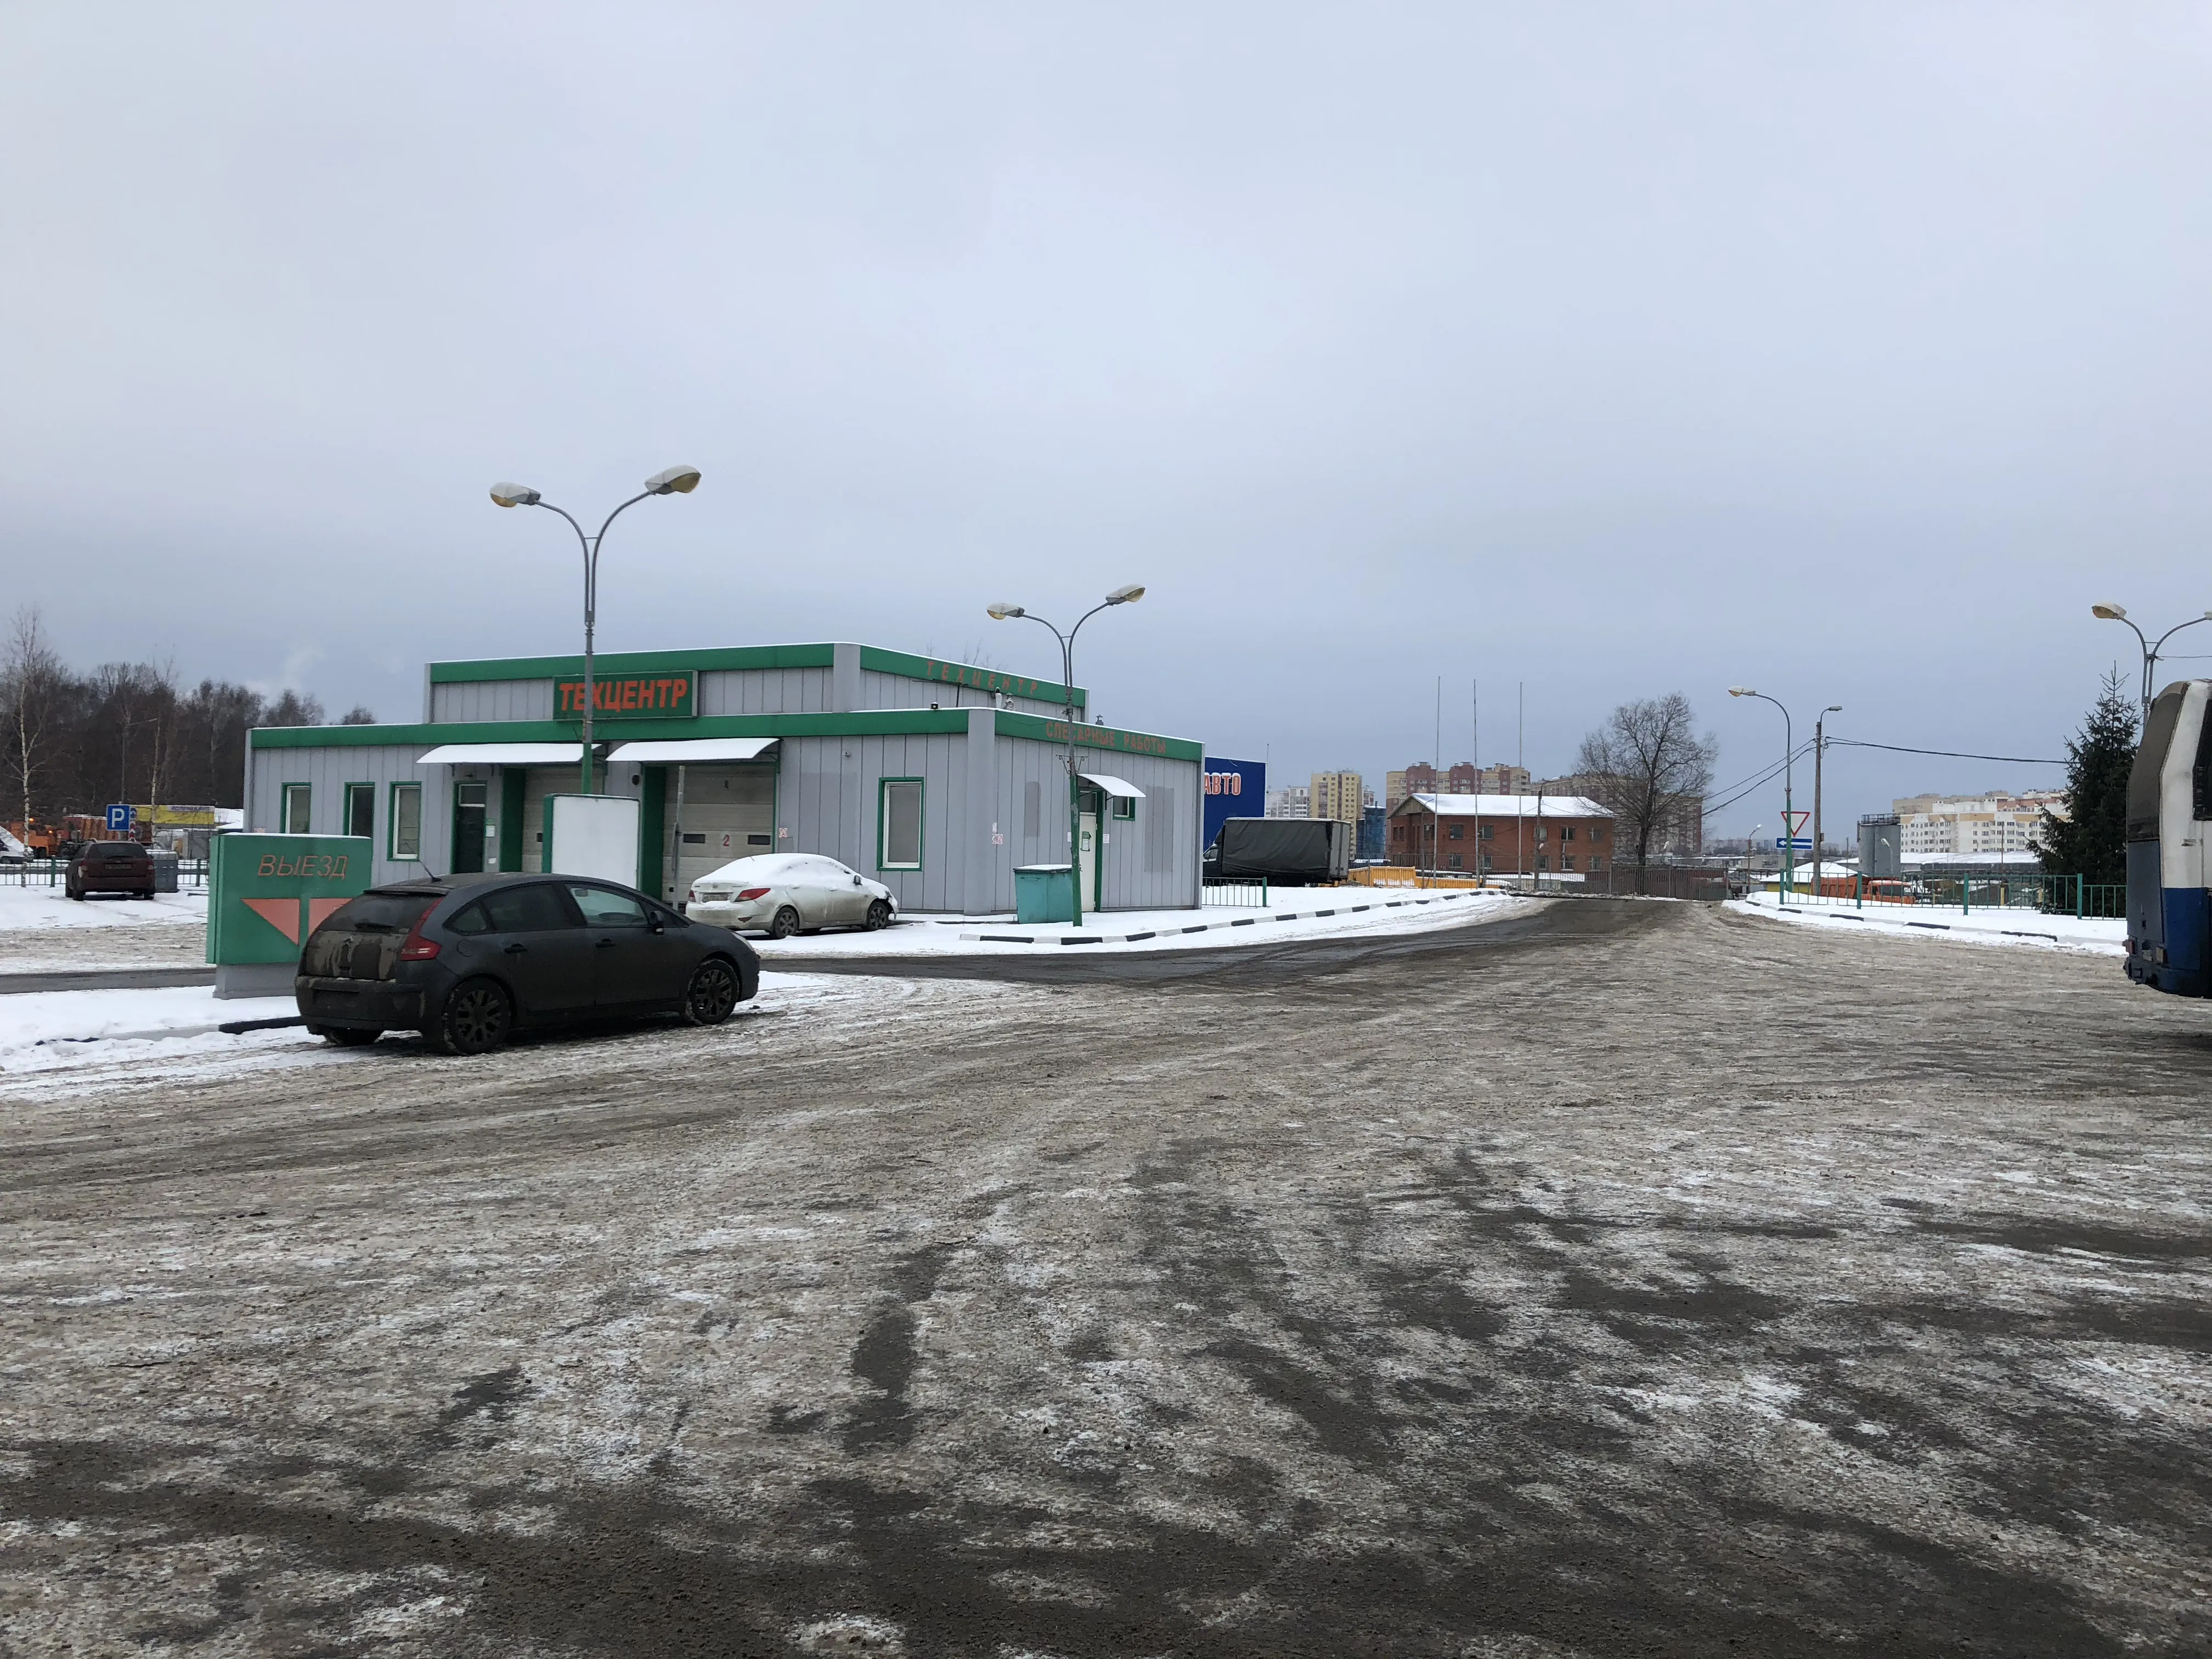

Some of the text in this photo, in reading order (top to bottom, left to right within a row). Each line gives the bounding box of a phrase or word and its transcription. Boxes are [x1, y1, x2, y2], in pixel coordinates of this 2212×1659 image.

[927, 661, 1037, 695] ТЕХЦЕНТР
[558, 678, 689, 713] ТЕХЦЕНТР
[1124, 733, 1166, 754] РАБОТЫ
[1204, 772, 1242, 795] АВТО
[722, 834, 731, 847] 2
[257, 854, 349, 882] ВЫЕЗД
